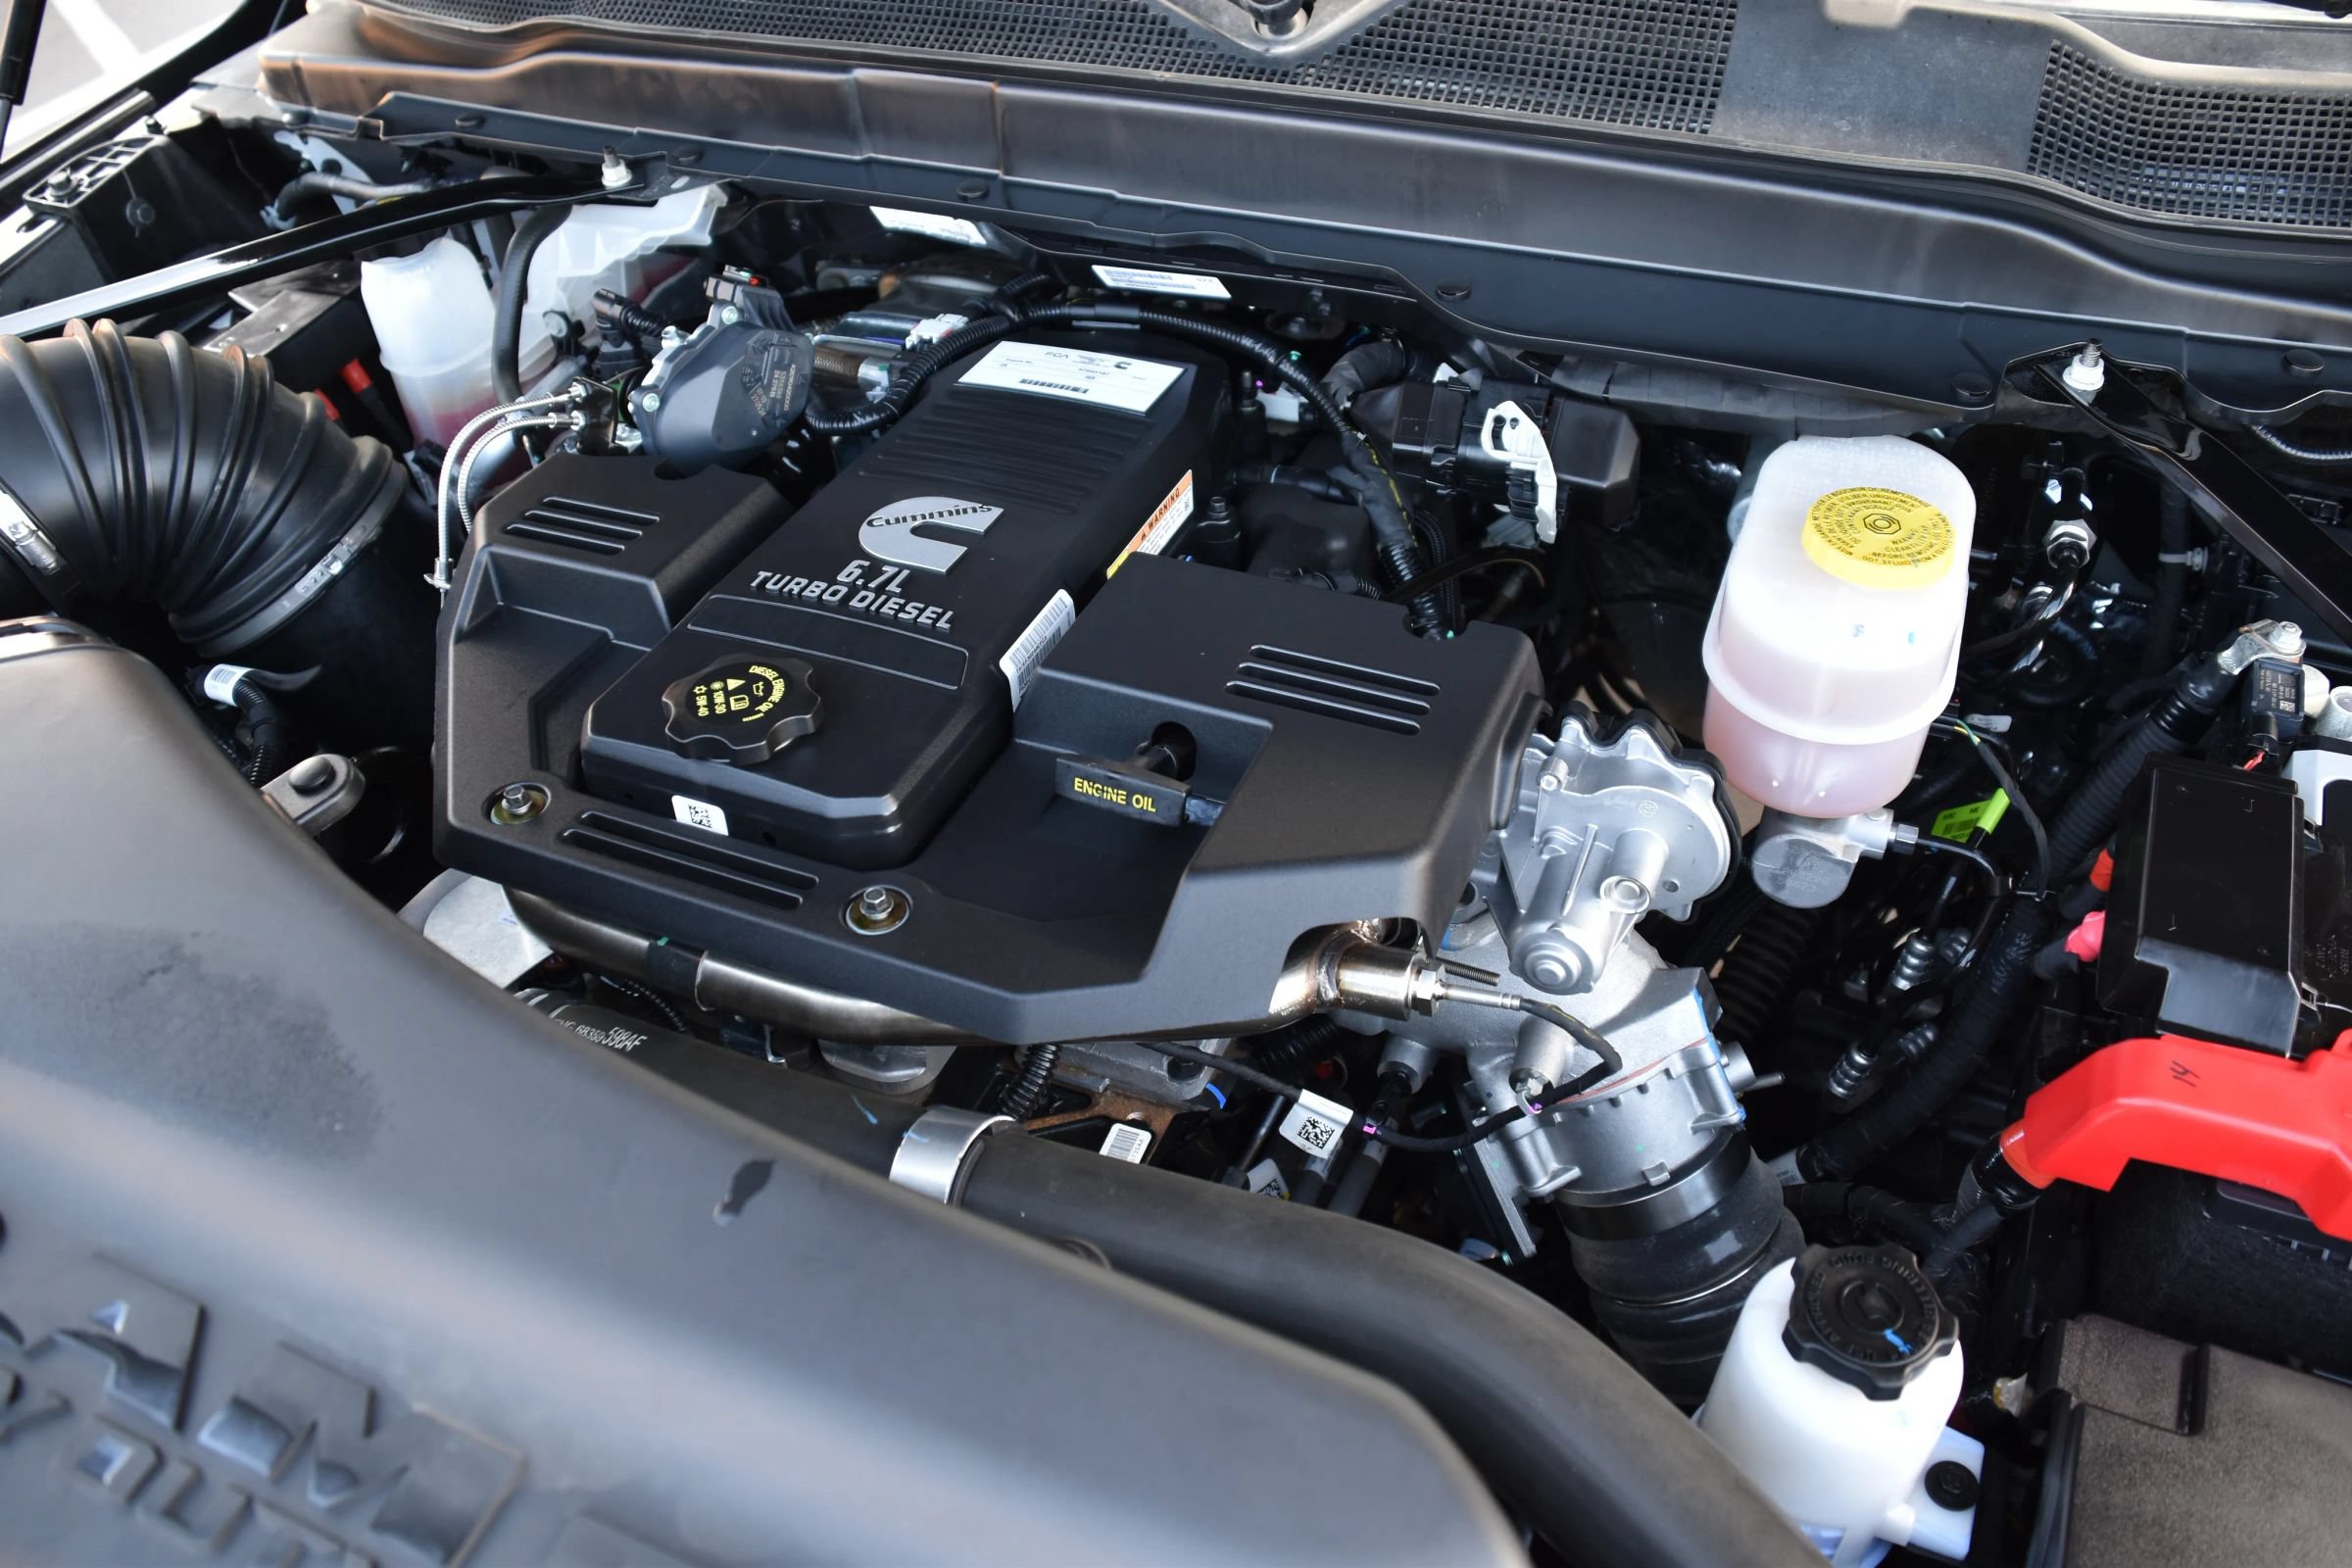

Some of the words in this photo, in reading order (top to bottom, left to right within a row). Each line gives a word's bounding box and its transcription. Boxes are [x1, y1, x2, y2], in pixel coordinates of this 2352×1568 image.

[866, 504, 992, 528] Cummins
[1149, 488, 1179, 530] WARNING
[836, 560, 911, 593] 6.7L
[750, 571, 849, 604] TURBO
[849, 590, 954, 632] DIESEL
[749, 665, 780, 681] DIESEL
[713, 690, 727, 714] 10W-30
[767, 678, 785, 704] ENGINE
[695, 695, 710, 717] 5W-40
[755, 702, 774, 713] OIL
[1074, 777, 1127, 805] ENGINE
[1132, 794, 1156, 812] OIL
